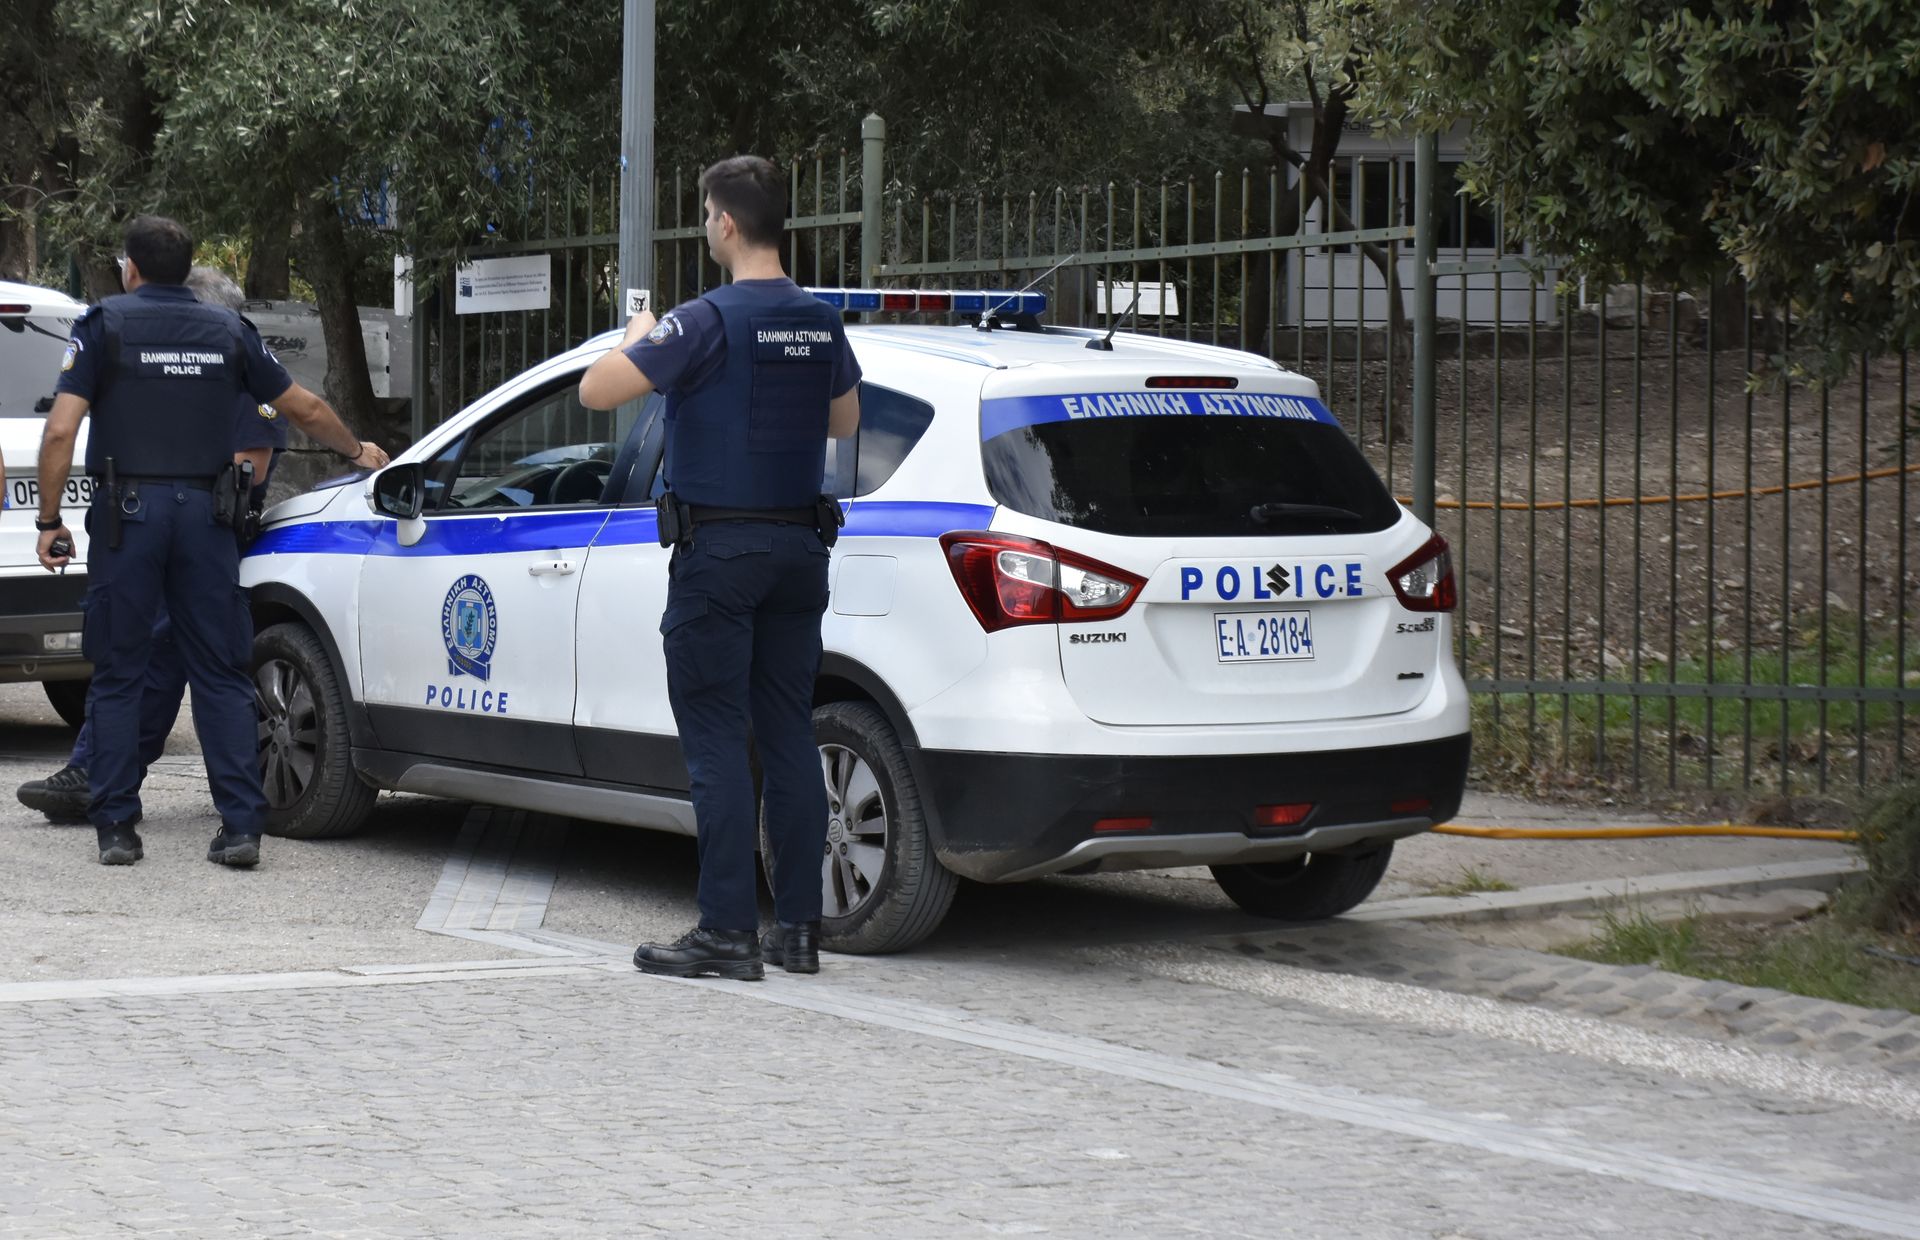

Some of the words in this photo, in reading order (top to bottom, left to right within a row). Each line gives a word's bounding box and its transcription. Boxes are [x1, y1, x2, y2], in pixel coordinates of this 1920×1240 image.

[758, 330, 794, 343] ΕΛΛΗΝΙΚΗ
[795, 331, 832, 343] ΑΣΤΥΝΟΜΙΑ
[141, 352, 180, 364] ΕΛΛΗΝΙΚΗ
[181, 353, 224, 365] ΑΣΤΥΝΟΜΙΑ
[784, 346, 811, 356] POLICE
[163, 366, 202, 375] POLICE
[1061, 394, 1192, 420] ΕΛΛΗΝΙΚΗ
[1199, 394, 1318, 421] ΑΣΤΥΝΟΜΙΑ
[1180, 563, 1363, 601] POLICE
[443, 577, 468, 649] ΕΛΛΗΝΙΚΗ
[472, 577, 496, 656] ΑΣΤΥΝΟΜΙΑ
[1069, 631, 1127, 645] SUZUKI
[1257, 616, 1312, 655] 28184
[425, 684, 508, 713] POLICE
